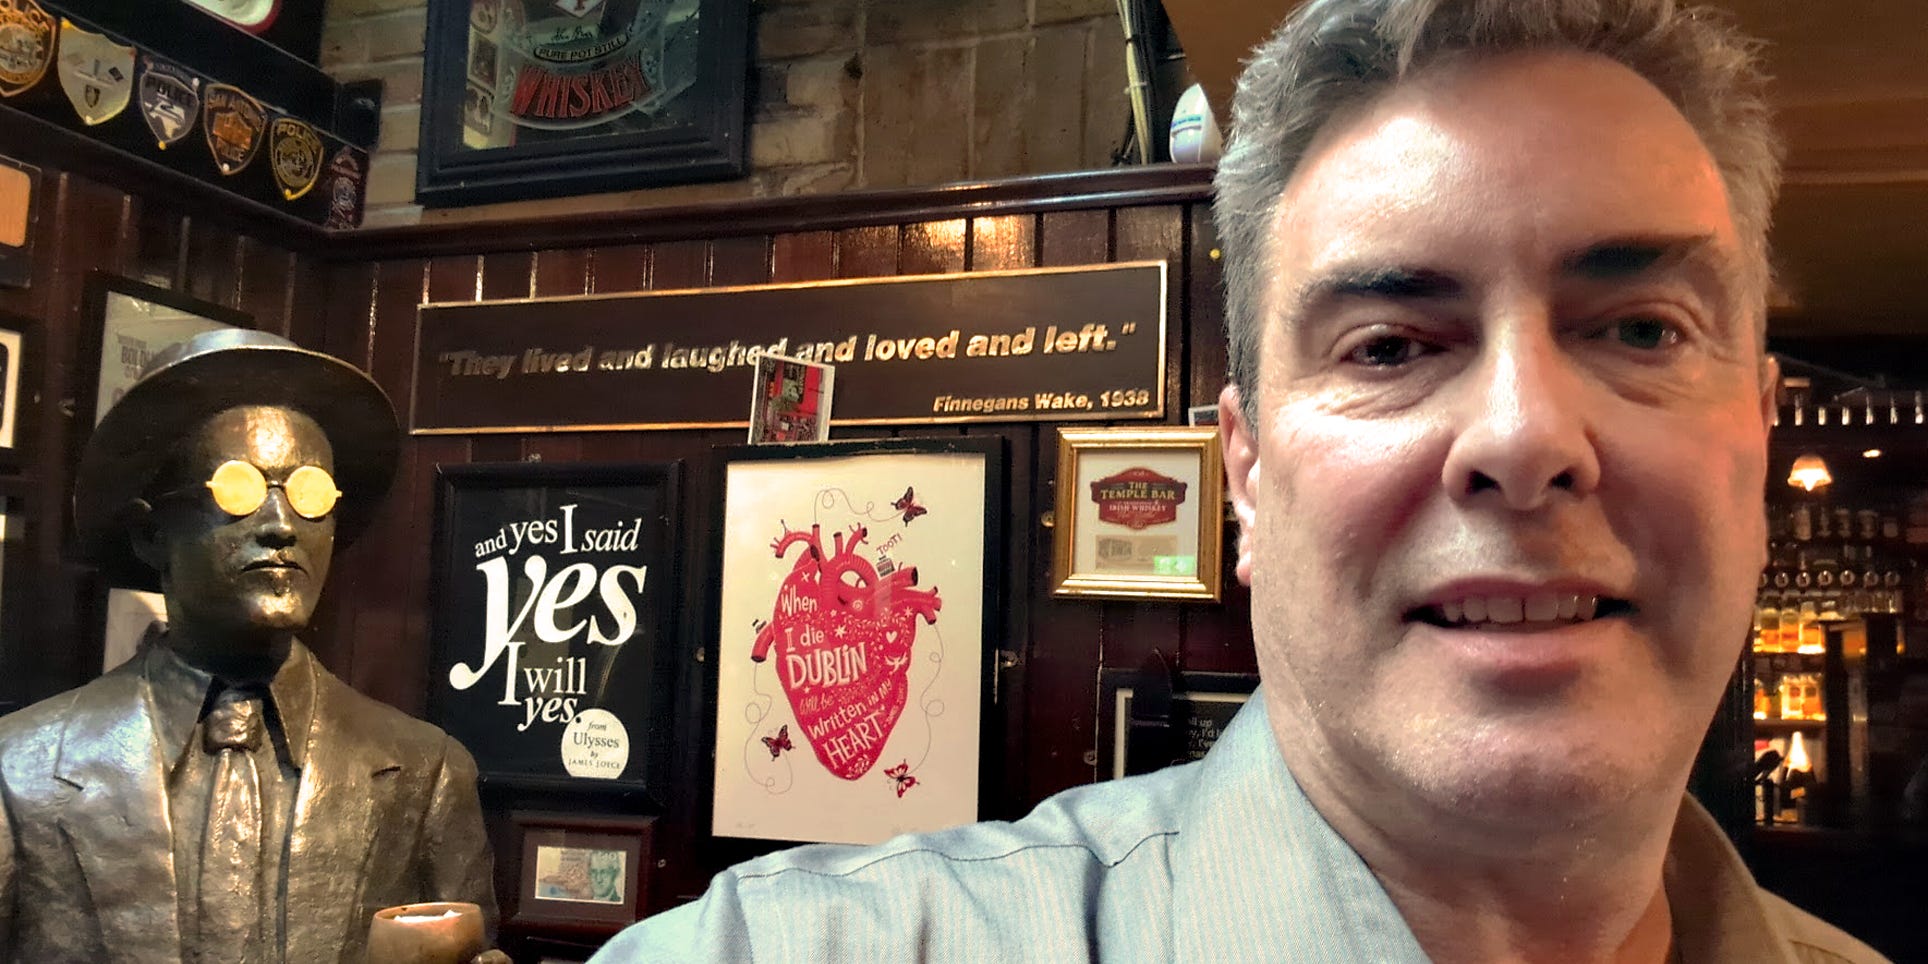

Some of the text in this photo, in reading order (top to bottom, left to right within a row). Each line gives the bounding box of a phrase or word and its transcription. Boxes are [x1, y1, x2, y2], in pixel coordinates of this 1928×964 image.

[509, 56, 650, 118] WHISKEY
[522, 346, 592, 374] lived
[598, 343, 655, 370] and
[661, 336, 788, 373] laughed
[795, 334, 857, 363] and
[865, 330, 960, 361] loved
[966, 326, 1036, 357] and
[1043, 321, 1137, 354] left."
[933, 389, 1150, 414] Finnegans Wake, 1938
[1100, 489, 1176, 500] TEMPLE BAR
[1128, 481, 1148, 490] THE
[475, 504, 643, 557] and yes I said
[781, 584, 817, 617] When
[449, 554, 648, 690] yes
[785, 623, 825, 653] I die
[498, 641, 587, 706] I will
[573, 731, 620, 749] Ulysses
[587, 721, 607, 731] from
[822, 711, 883, 769] HEART
